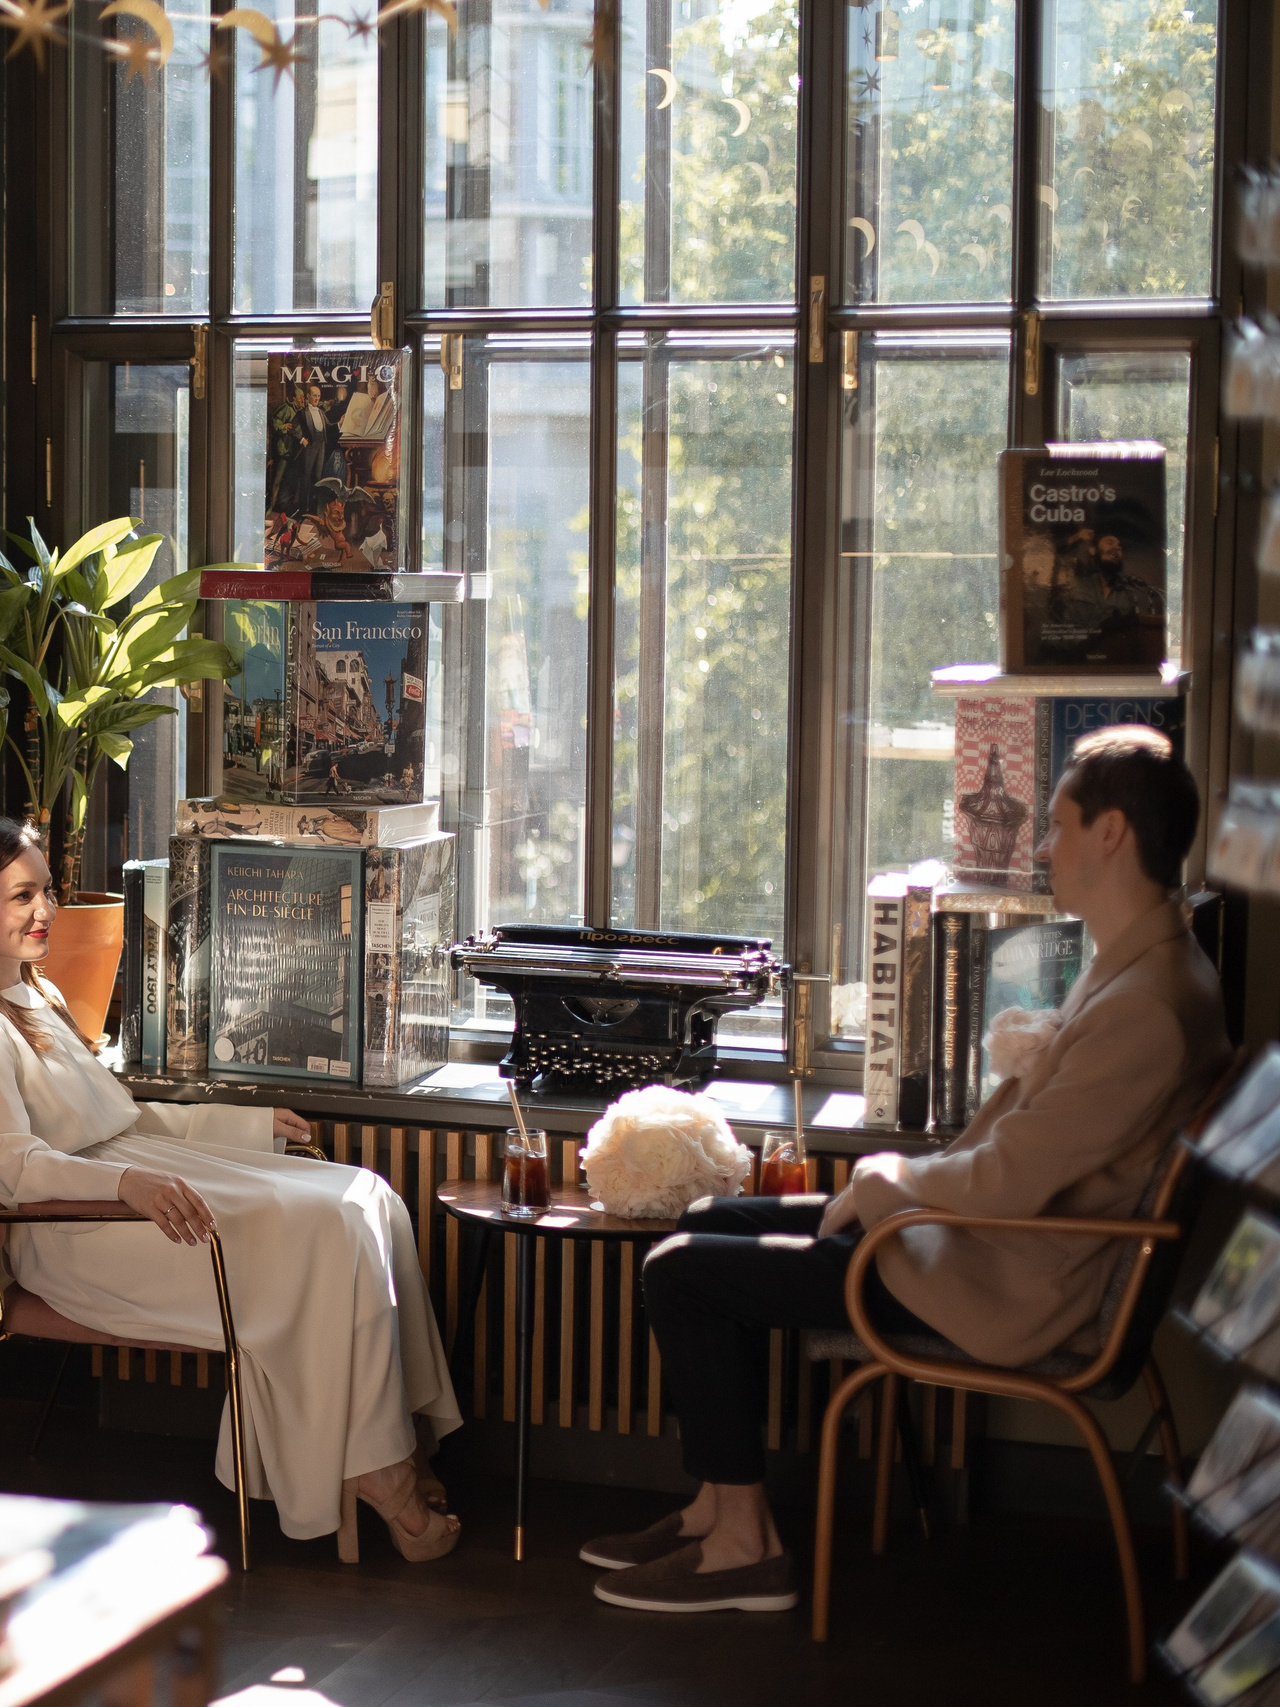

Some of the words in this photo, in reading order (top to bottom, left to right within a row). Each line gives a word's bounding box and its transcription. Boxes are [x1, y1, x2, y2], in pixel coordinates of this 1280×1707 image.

[1040, 467, 1055, 477] Lee
[1056, 467, 1099, 477] Lockwood
[1030, 483, 1117, 502] Castro's
[1030, 503, 1086, 522] Cuba
[239, 613, 281, 640] Berlin
[311, 619, 343, 641] San
[345, 619, 422, 641] Francisco
[286, 625, 297, 656] San
[284, 659, 297, 743] Francisco
[1064, 701, 1166, 730] DESIGNS
[1039, 703, 1050, 756] DESIGNS
[1039, 757, 1050, 778] FOR
[1038, 780, 1050, 839] LEARNING
[226, 866, 262, 880] KEIICHI
[264, 867, 304, 881] TAHARA
[226, 889, 324, 907] ARCHITECTURE
[226, 901, 315, 922] FIN-DE-SIÈCLE
[144, 925, 159, 973] ITALY
[578, 930, 680, 947] Прогресс
[945, 948, 960, 1001] Fashion
[971, 964, 981, 991] TONY
[144, 974, 158, 1015] 1900
[868, 901, 898, 1079] HABITAT
[945, 1005, 960, 1070] Designers
